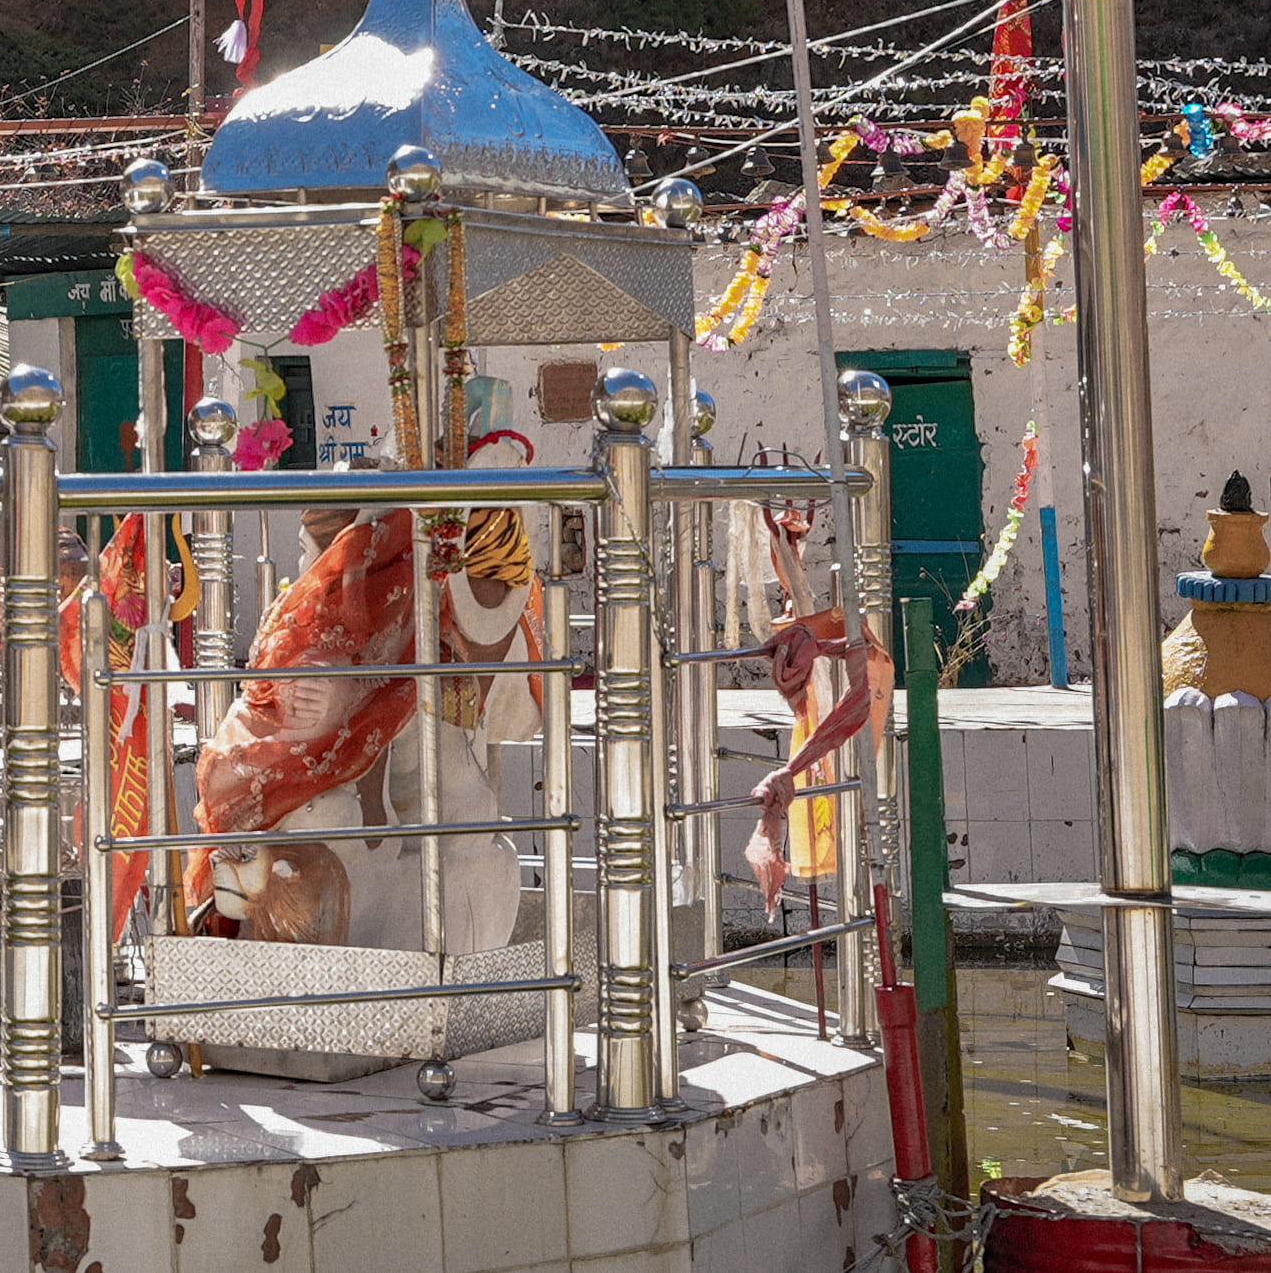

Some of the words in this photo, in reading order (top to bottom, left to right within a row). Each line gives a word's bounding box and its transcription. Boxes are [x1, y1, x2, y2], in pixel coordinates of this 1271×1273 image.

[322, 405, 357, 429] जय
[892, 414, 939, 449] स्टोर
[319, 434, 337, 463] श्री
